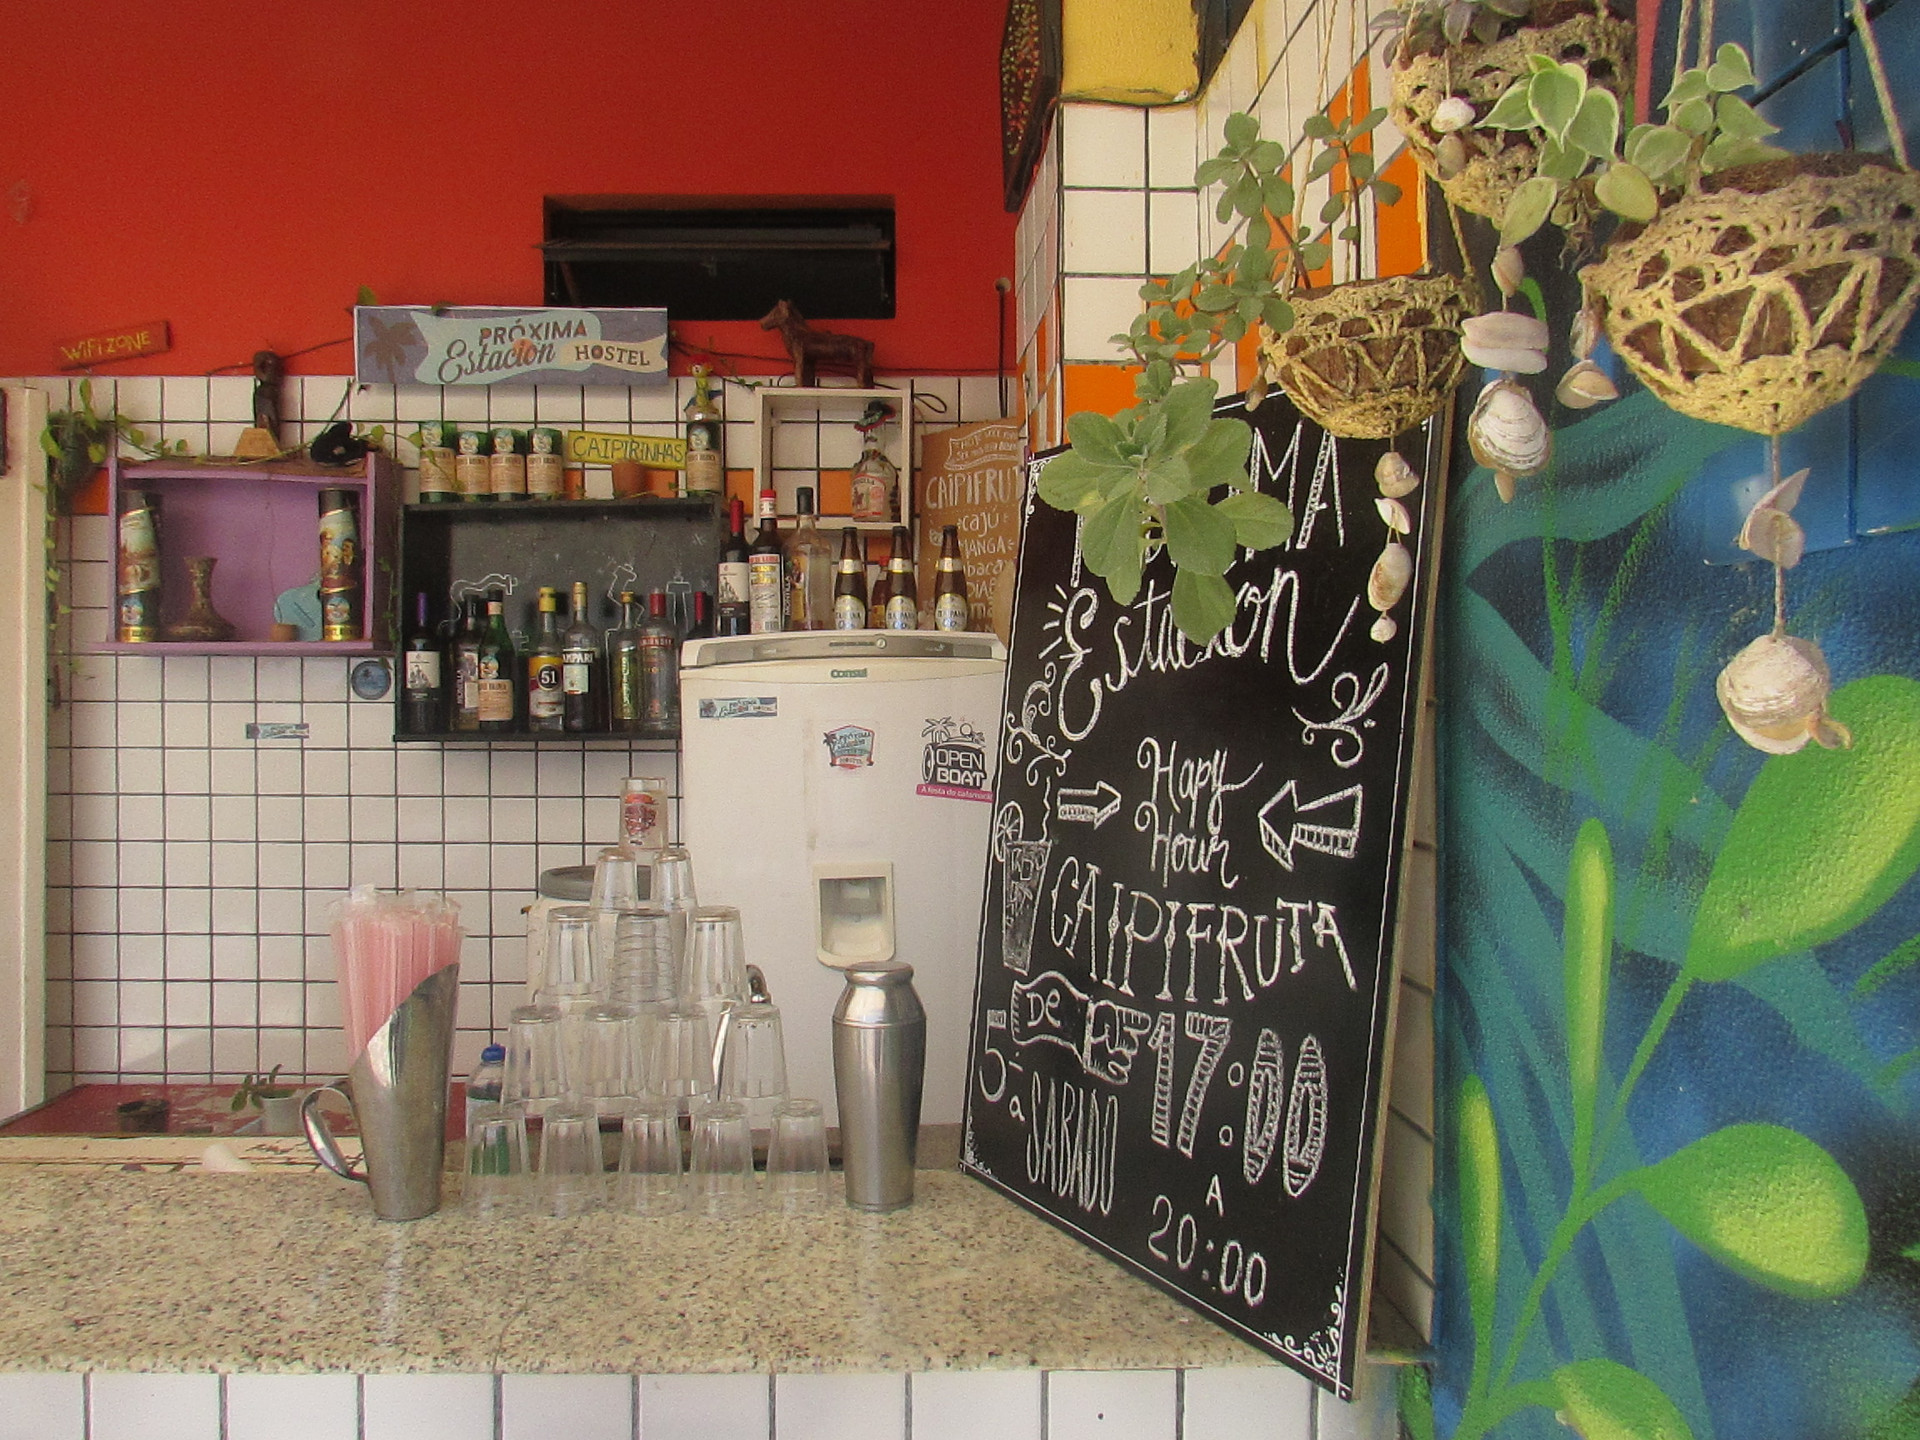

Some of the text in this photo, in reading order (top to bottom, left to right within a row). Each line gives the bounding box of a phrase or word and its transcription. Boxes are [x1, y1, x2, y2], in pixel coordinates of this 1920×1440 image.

[106, 330, 152, 353] ZONE
[479, 318, 588, 346] PRÓXIMA
[575, 344, 651, 367] HOSTEL
[572, 435, 687, 464] CAIPIRINHAS
[562, 651, 594, 664] AMPARI
[540, 670, 558, 685] 51
[936, 748, 984, 770] OPEN
[936, 767, 986, 787] BOAT
[1136, 736, 1264, 836] Hapy
[1134, 801, 1239, 889] Hour
[1050, 855, 1359, 1007] CAIPIFRUTA
[1147, 1011, 1329, 1198] 17:00
[1205, 1173, 1225, 1217] A
[1148, 1194, 1267, 1307] 20:00
